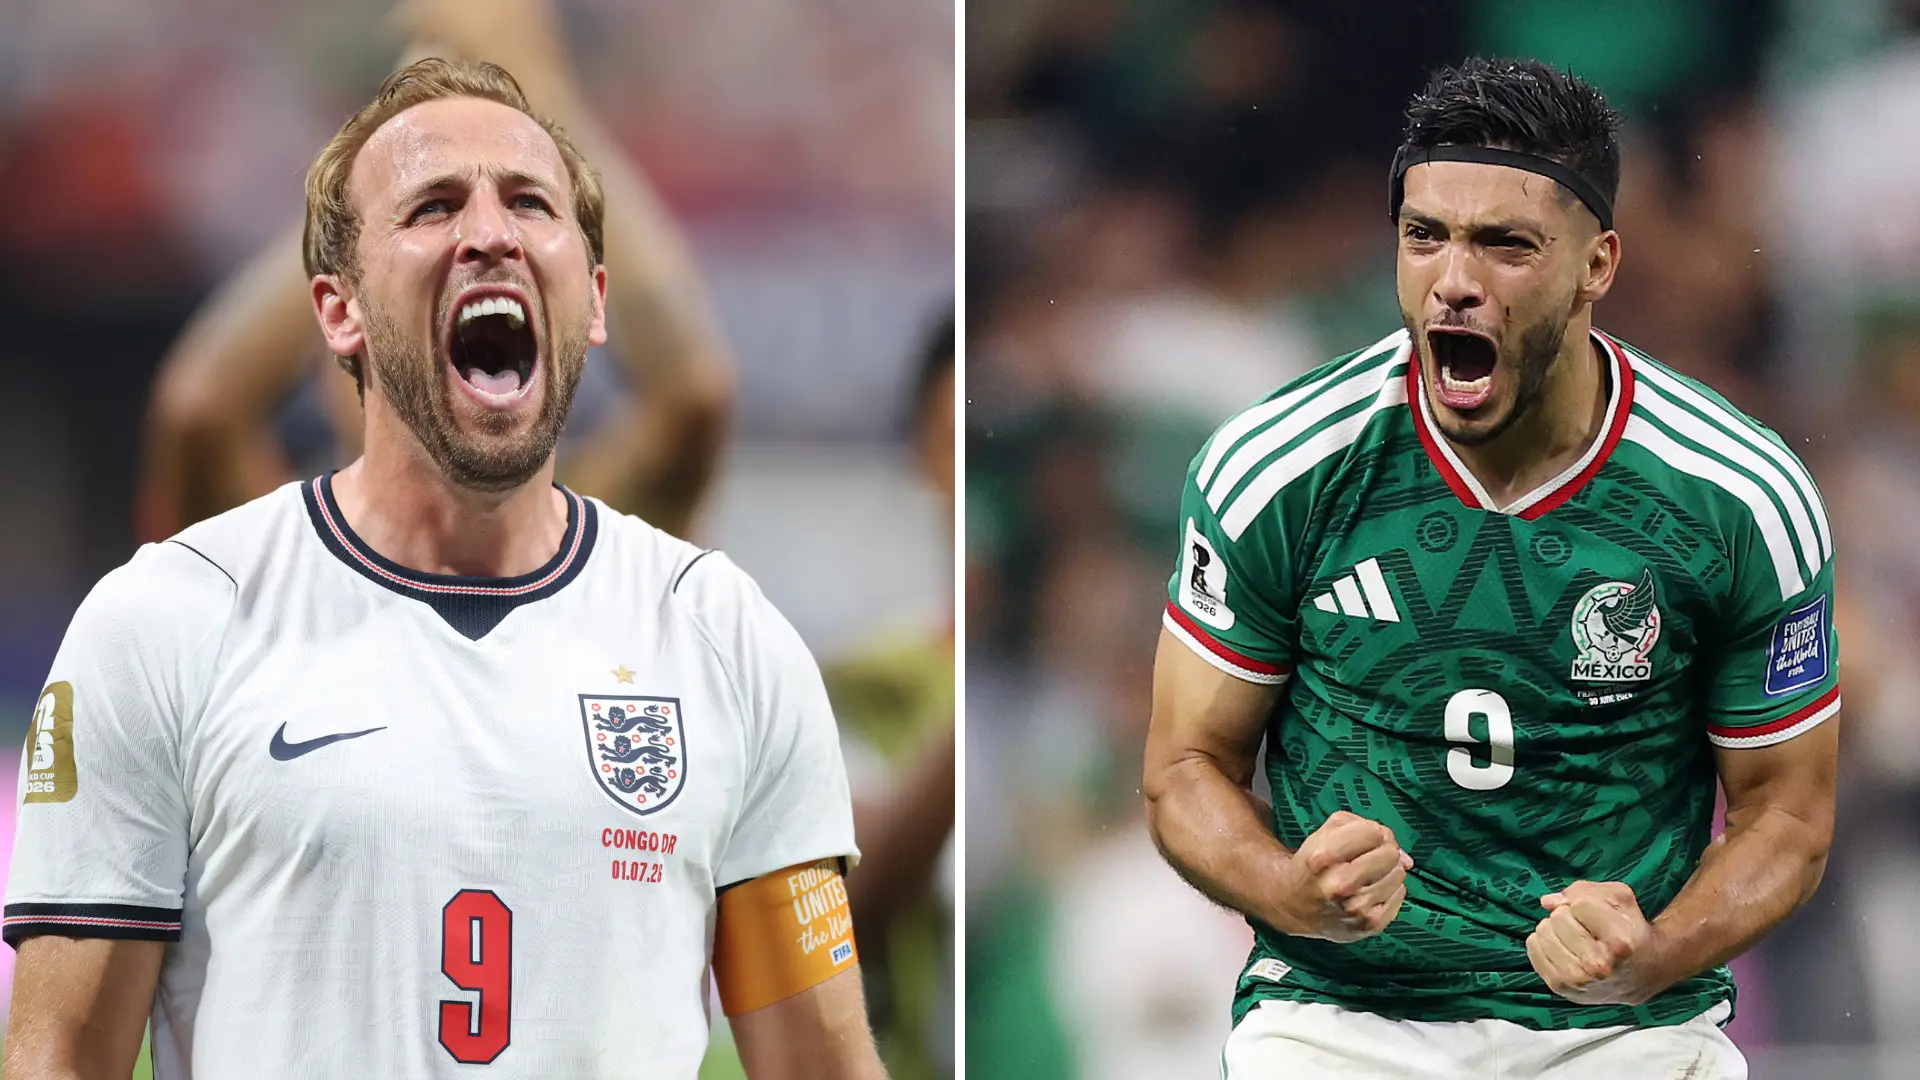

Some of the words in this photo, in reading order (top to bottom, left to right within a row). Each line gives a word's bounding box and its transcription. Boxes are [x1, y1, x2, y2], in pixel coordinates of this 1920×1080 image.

[1574, 661, 1649, 678] MÉXICO
[1444, 688, 1515, 791] 9
[40, 772, 55, 780] CUP
[602, 828, 659, 851] CONGO
[661, 833, 678, 855] DR
[611, 860, 663, 883] 01.07.26
[797, 926, 829, 955] the
[832, 944, 851, 962] FIFA
[438, 888, 513, 1065] 9
